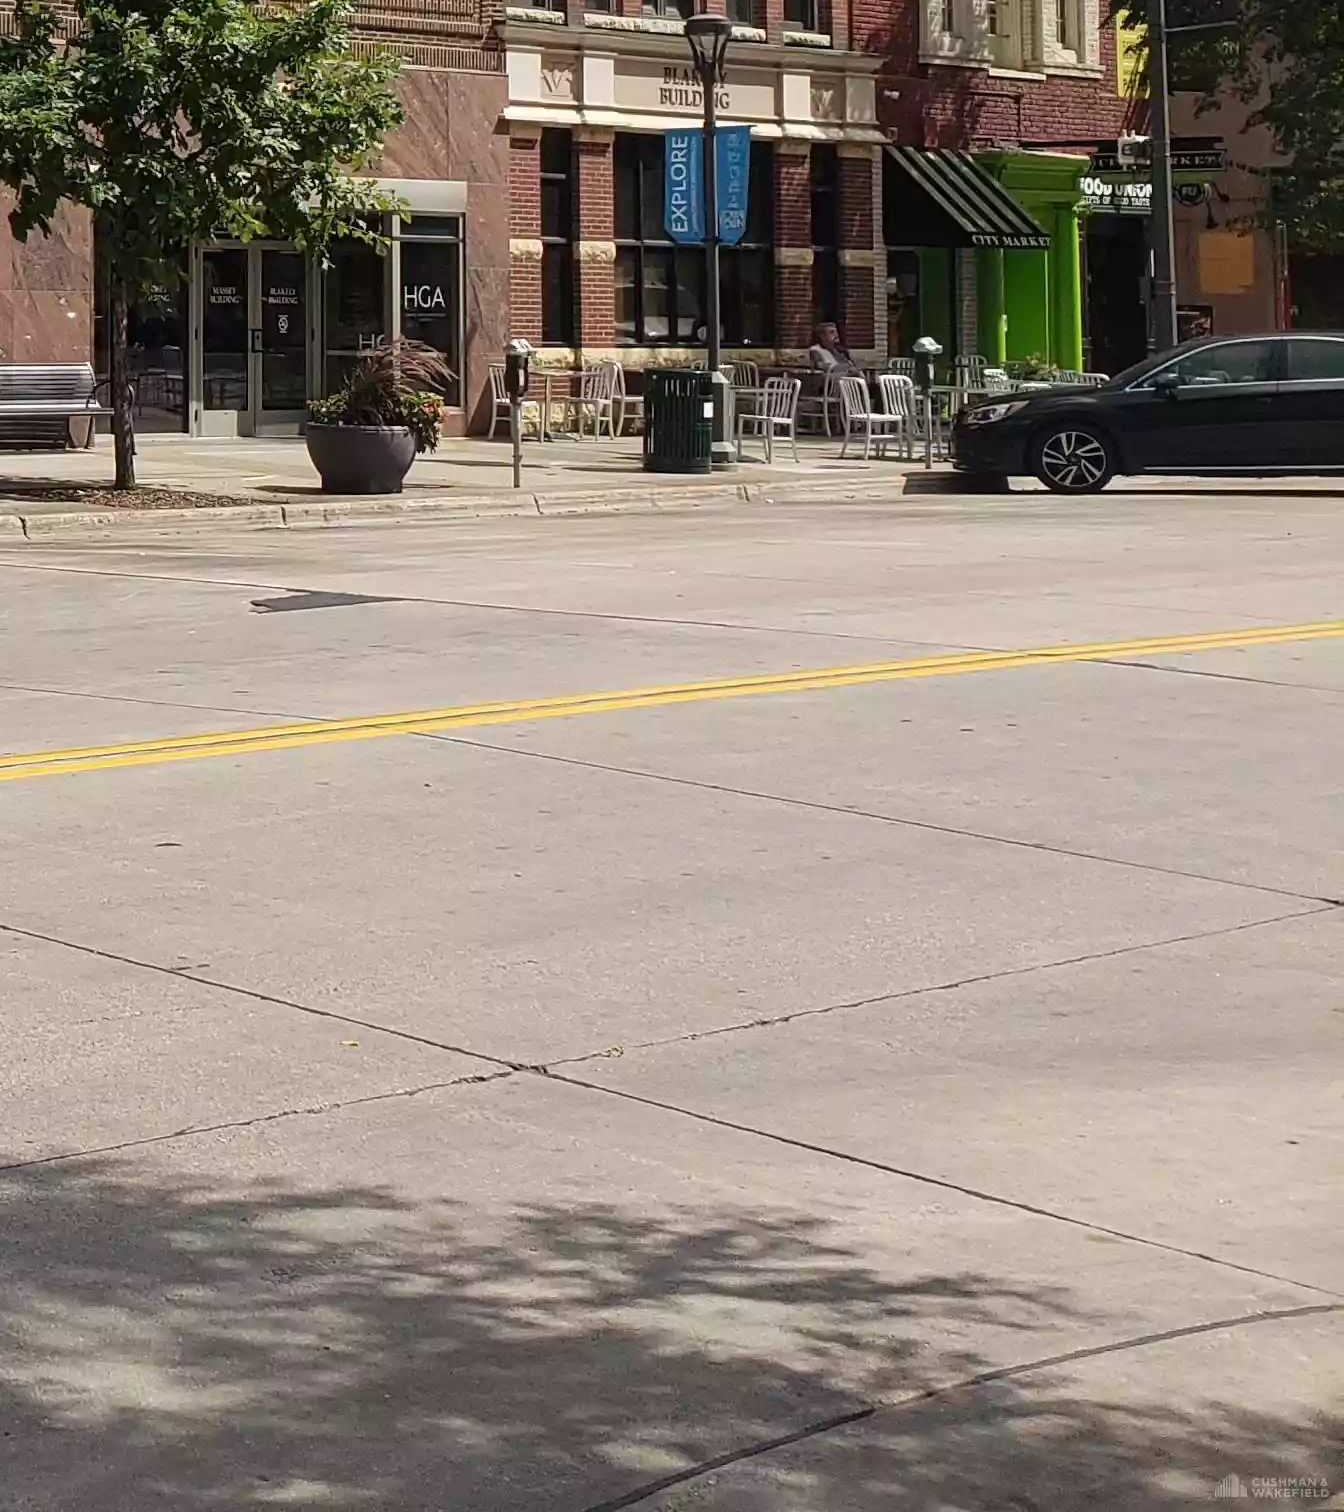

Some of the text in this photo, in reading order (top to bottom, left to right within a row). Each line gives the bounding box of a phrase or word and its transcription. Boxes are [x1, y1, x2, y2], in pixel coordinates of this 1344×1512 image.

[671, 135, 689, 233] EXPLORE
[972, 234, 1052, 247] CITY MARKET
[404, 285, 446, 308] HGA
